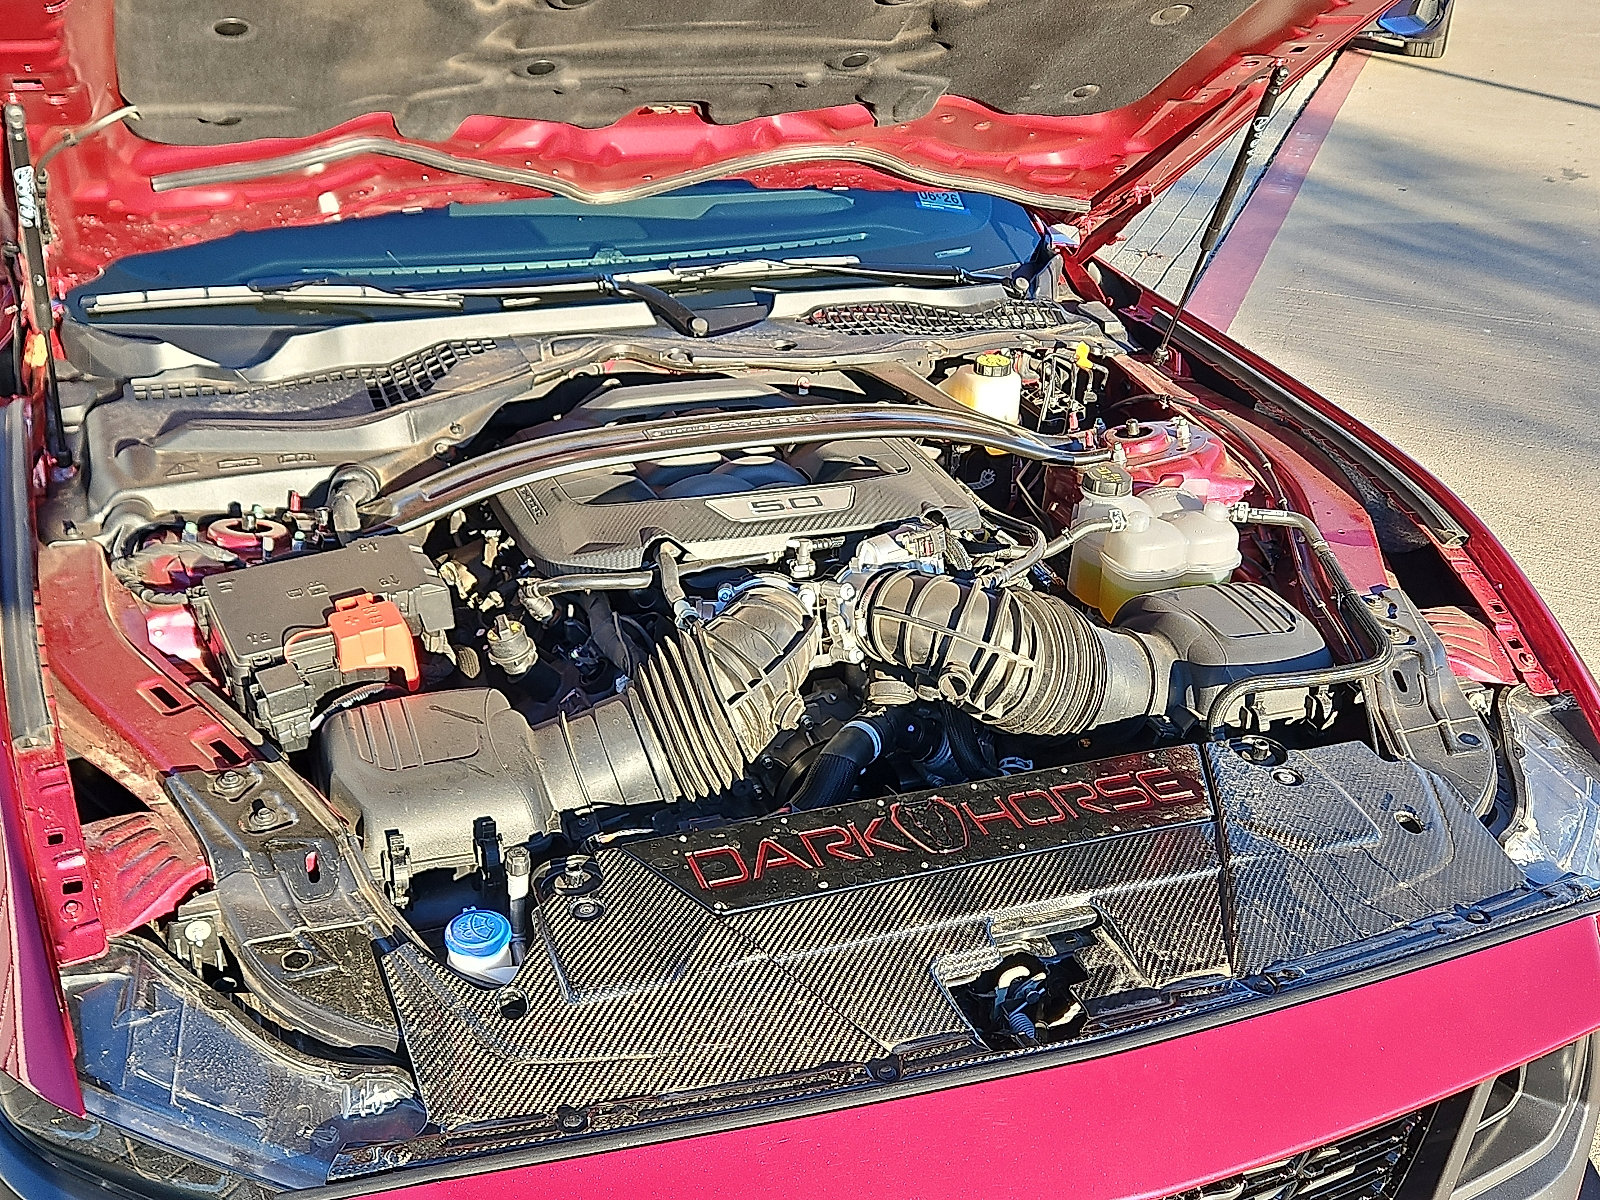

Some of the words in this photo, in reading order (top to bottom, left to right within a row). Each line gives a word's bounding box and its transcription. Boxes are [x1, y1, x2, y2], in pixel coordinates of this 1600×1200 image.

[750, 495, 823, 513] 5.0
[685, 817, 909, 890] DARK
[961, 767, 1196, 835] HORSE
